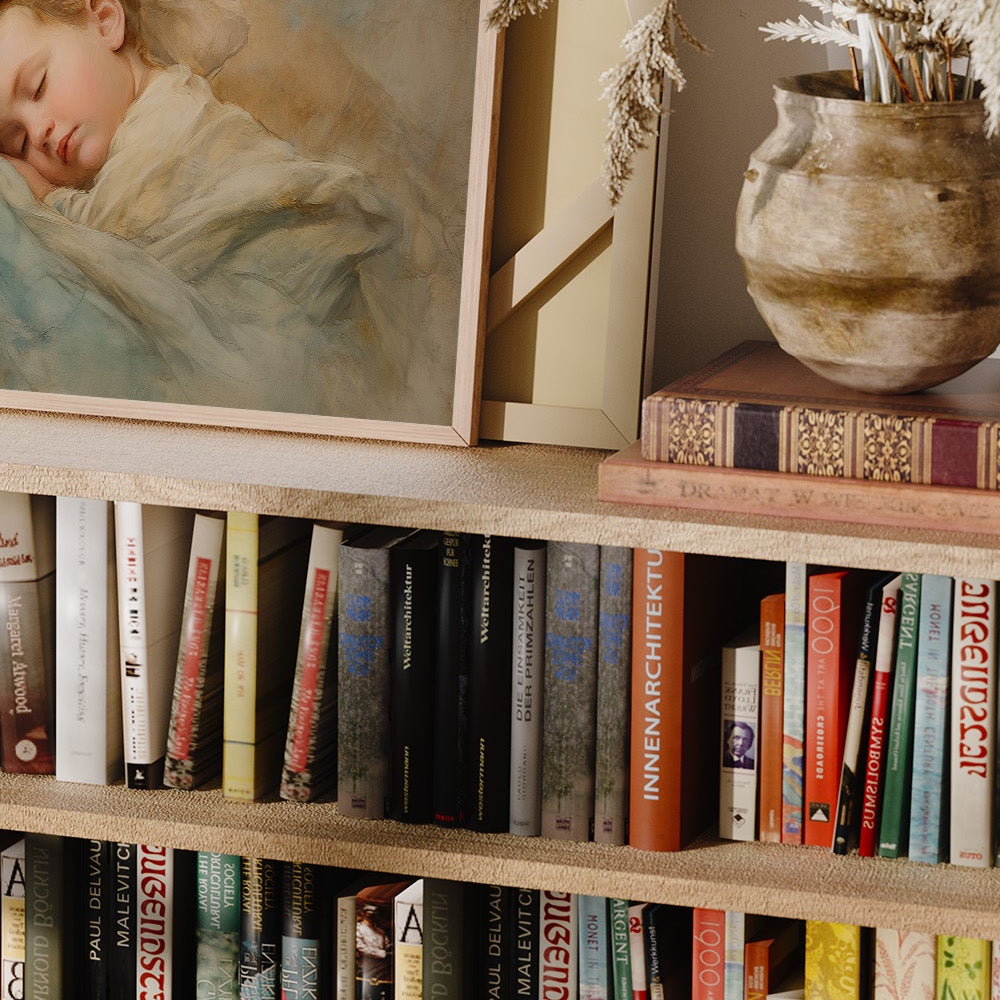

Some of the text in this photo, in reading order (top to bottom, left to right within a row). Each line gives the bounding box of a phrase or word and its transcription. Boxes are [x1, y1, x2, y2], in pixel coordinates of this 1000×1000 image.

[6, 596, 32, 714] Margaret Atwood
[403, 562, 413, 671] Weltarchitektur
[516, 574, 527, 723] DIE EINSAMKEIT
[524, 558, 536, 722] DER PRIMZAHLEN
[643, 549, 664, 801] INNENARCHITEKTU
[477, 737, 486, 821] westermann
[89, 840, 102, 962] PAUL DELVAU
[140, 845, 167, 1000] JUGENDST
[487, 885, 502, 957] DELVAU
[586, 914, 599, 952] MONET
[614, 900, 629, 965] ARGENT
[648, 926, 662, 975] Werkkunst
[694, 922, 721, 987] 1900
